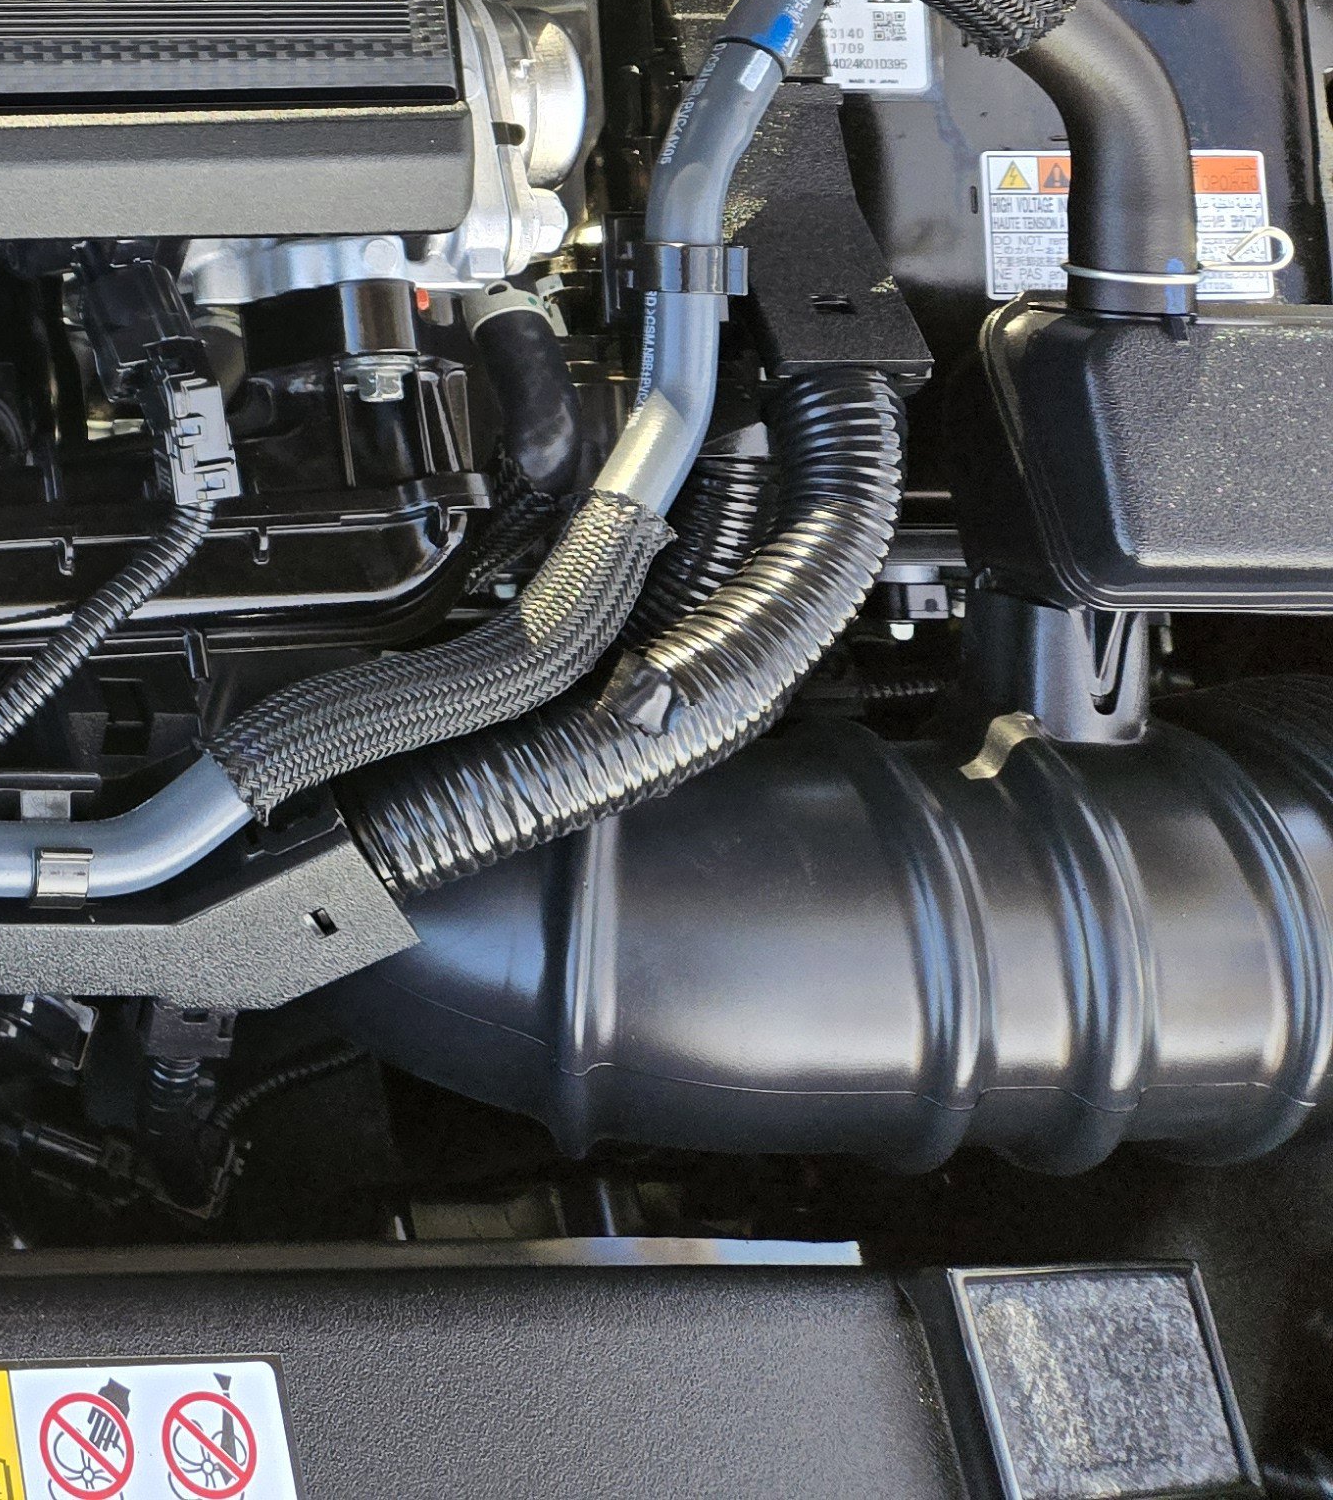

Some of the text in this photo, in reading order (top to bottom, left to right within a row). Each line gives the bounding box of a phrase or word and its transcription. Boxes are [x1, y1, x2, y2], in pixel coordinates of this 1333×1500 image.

[992, 197, 1013, 213] HIGH
[1017, 197, 1054, 213] VOLTAGE
[993, 217, 1020, 230] HAUTE
[1022, 217, 1058, 230] TENSION
[1018, 235, 1043, 245] NOT
[1020, 268, 1043, 280] PAS
